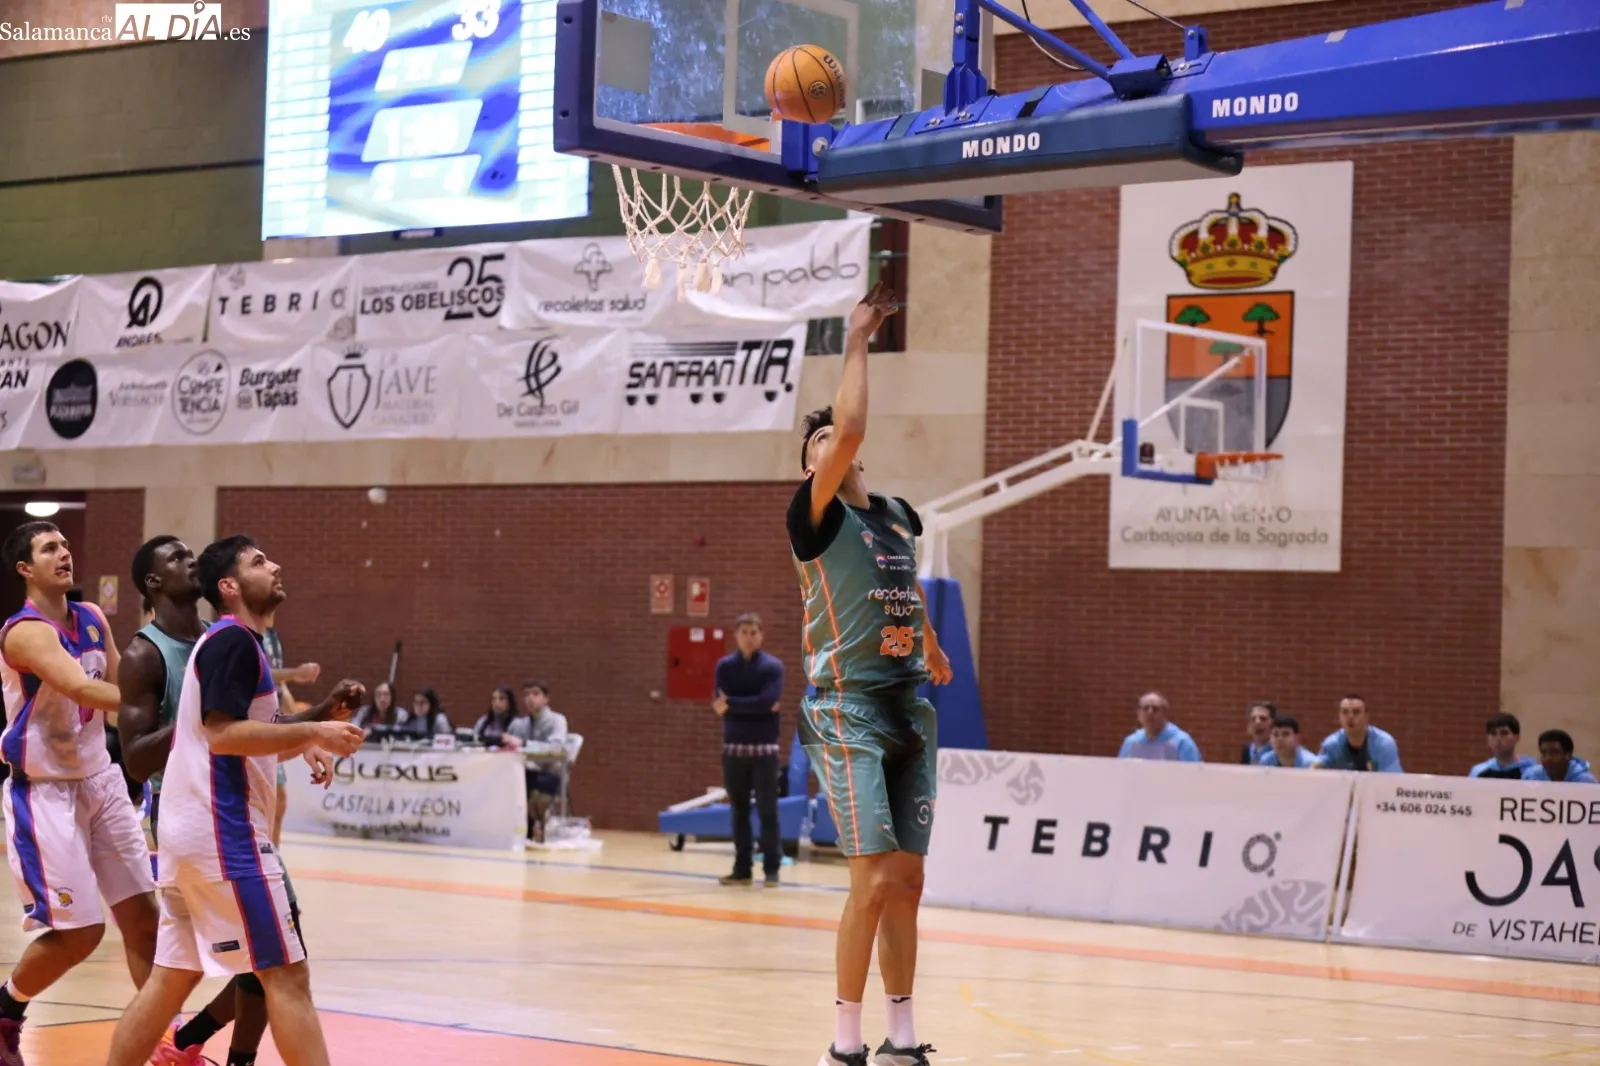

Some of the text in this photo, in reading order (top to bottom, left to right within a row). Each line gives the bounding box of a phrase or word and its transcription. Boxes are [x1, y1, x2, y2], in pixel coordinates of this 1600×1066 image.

[1212, 92, 1299, 119] MONDO
[962, 132, 1041, 159] MONDO
[763, 242, 860, 308] pablo
[360, 284, 506, 316] LOS OBELISCOS
[239, 367, 302, 391] Burguer
[255, 388, 299, 413] Tapas
[1121, 525, 1329, 548] Carbajosa de la Sagrada
[322, 792, 395, 815] CASTILLA
[1396, 787, 1453, 801] Reservas:
[1376, 802, 1473, 817] +34 606 024 545
[983, 814, 1282, 878] TEBRIO
[1452, 918, 1600, 945] DE VISTAHE
